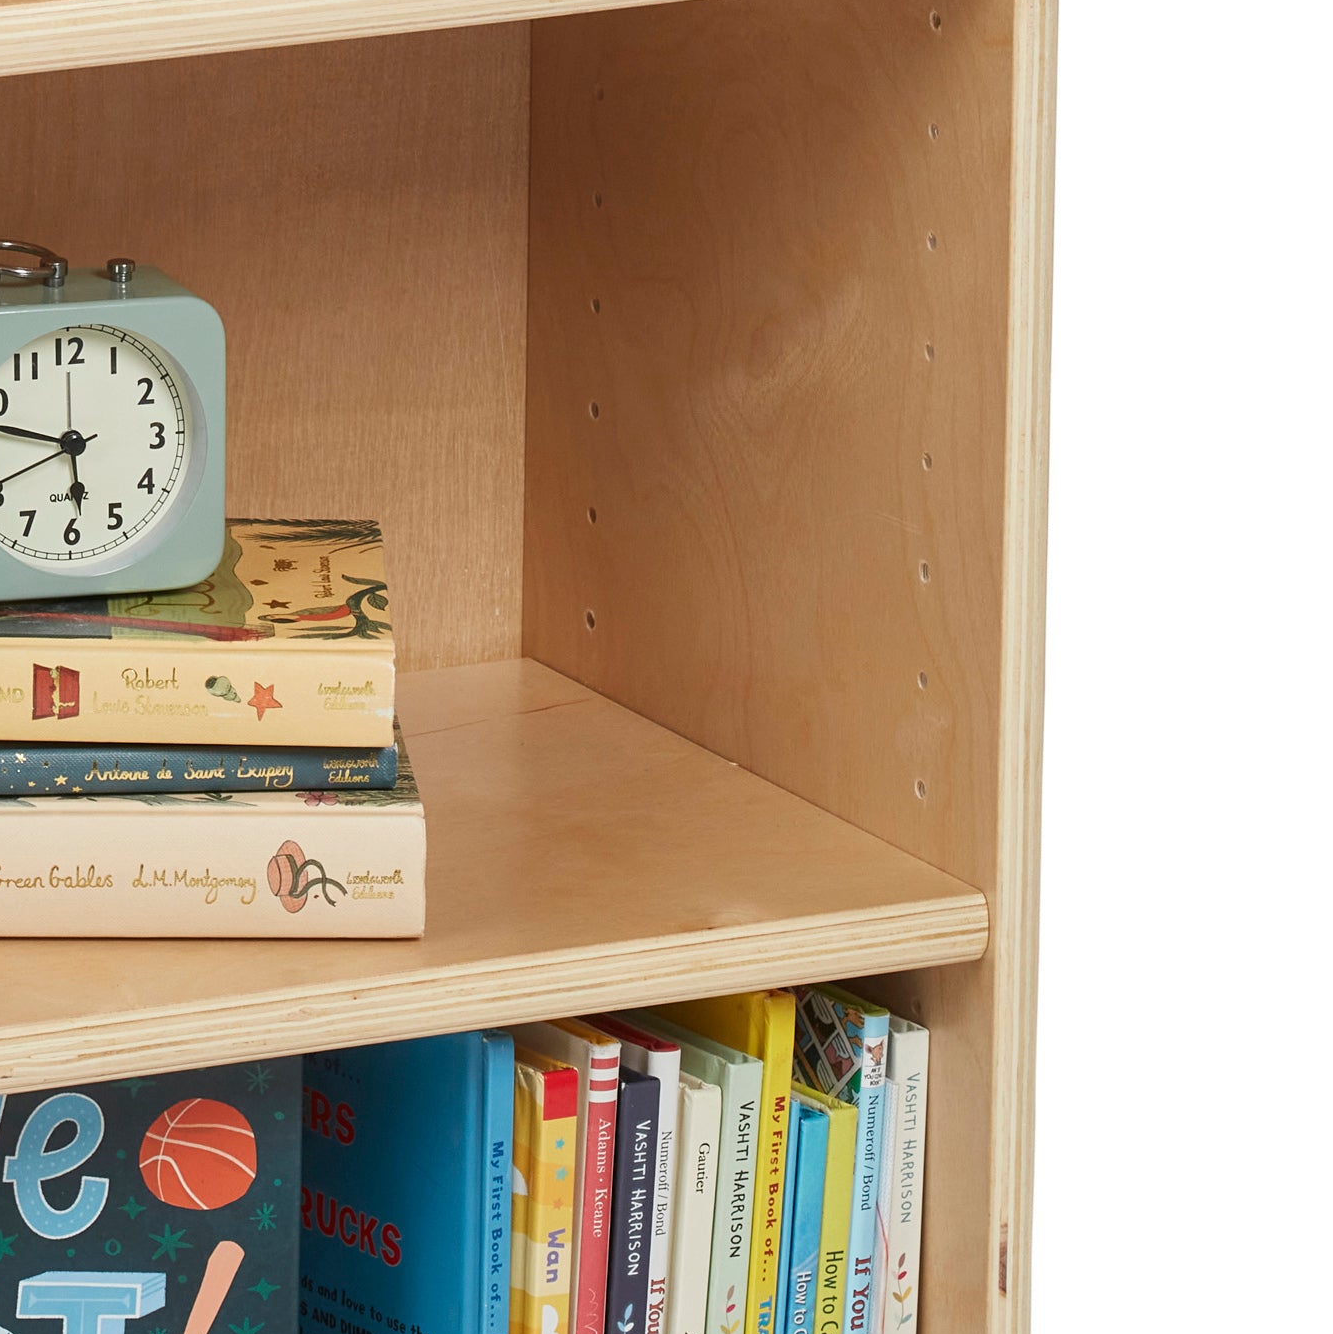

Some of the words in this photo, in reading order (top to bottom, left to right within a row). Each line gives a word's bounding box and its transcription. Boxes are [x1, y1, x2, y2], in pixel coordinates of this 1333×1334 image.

[55, 337, 85, 365] 12
[111, 346, 117, 374] 1
[14, 352, 38, 381] 11
[137, 378, 155, 405] 2
[149, 422, 165, 449] 3
[137, 468, 155, 495] 4
[50, 492, 89, 503] QUAZ
[19, 510, 36, 537] 7
[107, 503, 123, 529] 5
[64, 519, 81, 545] 6
[84, 760, 149, 782] Antoine
[157, 759, 173, 780] de
[50, 865, 113, 888] Gables
[903, 1073, 920, 1131] VASHTI
[865, 1095, 879, 1162] Numeroff
[490, 1141, 504, 1168] My
[595, 1118, 612, 1174] Adams
[695, 1142, 710, 1194] Gautier
[901, 1139, 917, 1224] HARRISON
[490, 1175, 503, 1221] First
[861, 1174, 874, 1211] Bond
[593, 1188, 608, 1238] Keane
[490, 1228, 503, 1275] Book
[546, 1228, 565, 1284] Wan
[855, 1257, 872, 1276] If
[312, 1306, 336, 1329] AND
[318, 1285, 337, 1301] and
[341, 1290, 366, 1314] love
[370, 1306, 382, 1322] to
[386, 1318, 406, 1334] use
[850, 1282, 869, 1331] You
